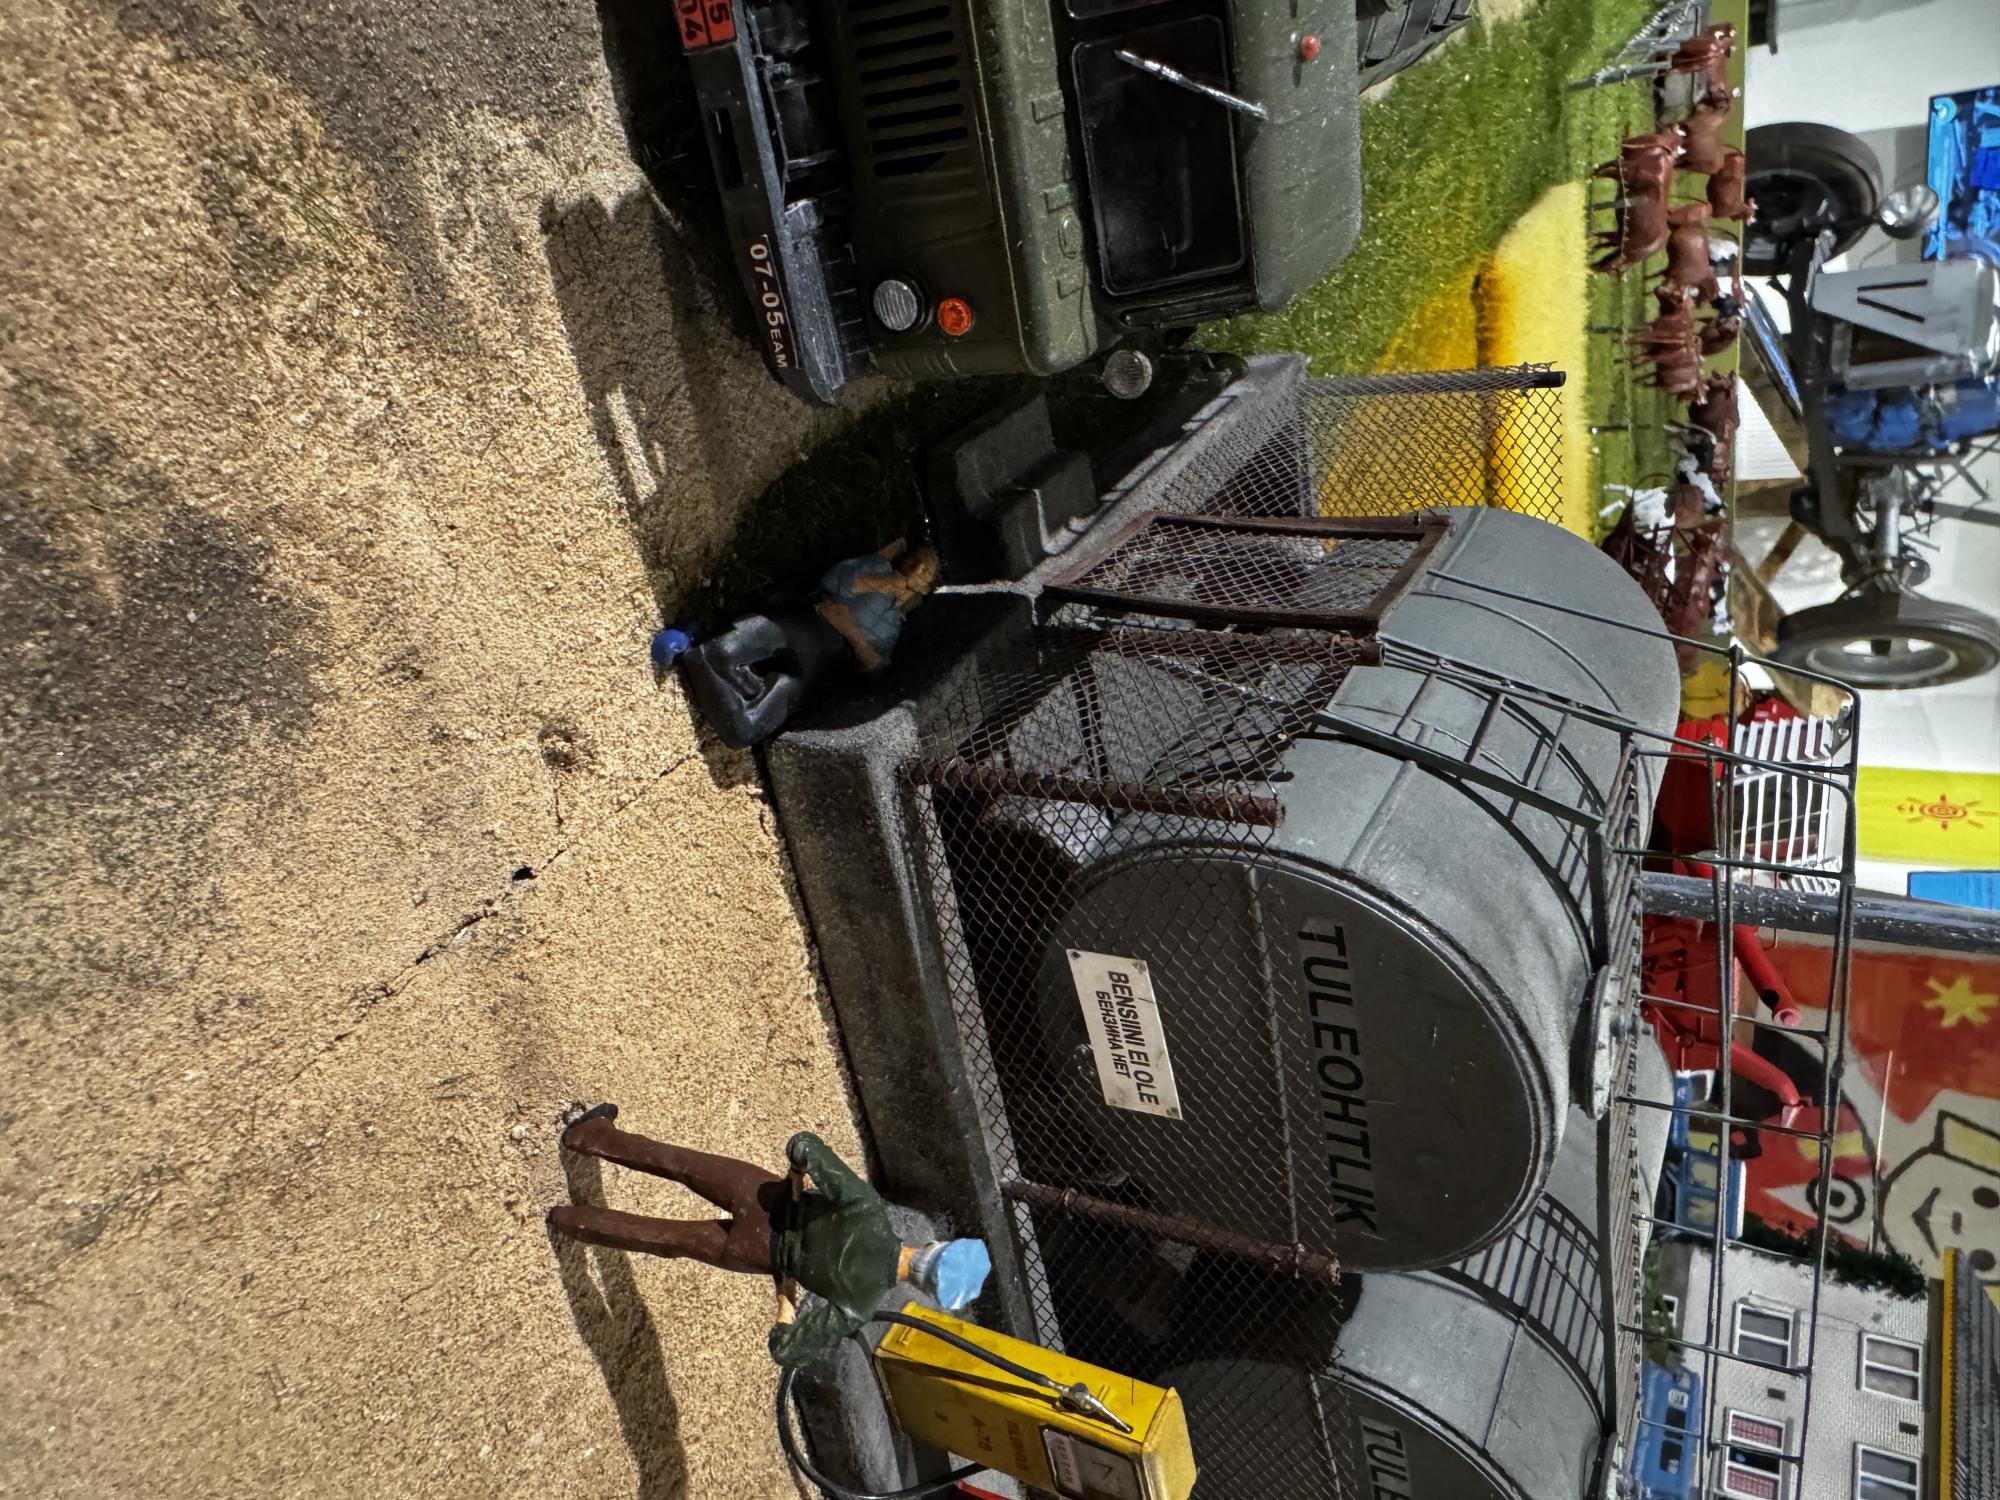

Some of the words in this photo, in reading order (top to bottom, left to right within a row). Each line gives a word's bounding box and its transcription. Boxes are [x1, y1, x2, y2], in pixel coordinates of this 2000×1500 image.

[710, 0, 729, 25] 5
[1096, 991, 1123, 1050] БЕНЗИНА
[1111, 1053, 1131, 1079] НЕТ
[1108, 971, 1145, 1047] BENSIINI
[1128, 1049, 1150, 1068] EI
[1299, 925, 1378, 1232] TULEOHTLIK
[1133, 1070, 1159, 1105] OLE
